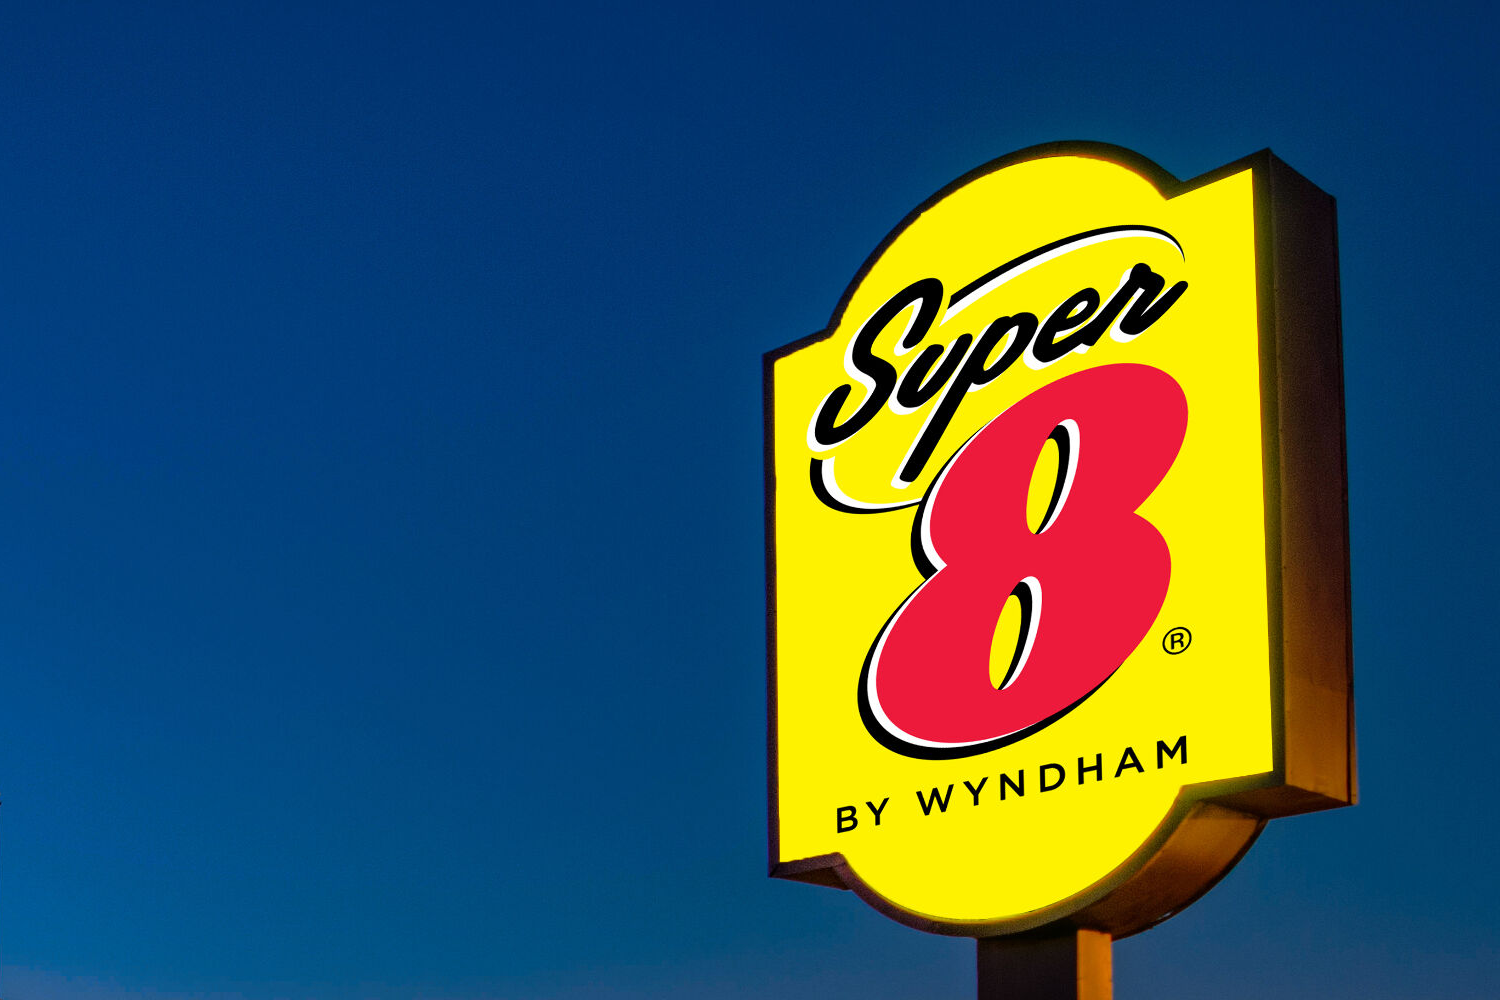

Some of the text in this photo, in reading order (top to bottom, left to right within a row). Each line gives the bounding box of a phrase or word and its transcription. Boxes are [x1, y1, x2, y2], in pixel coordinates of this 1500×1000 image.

[811, 262, 1189, 484] Super
[857, 362, 1190, 761] 8
[836, 735, 1189, 834] BY WYNDHAM
